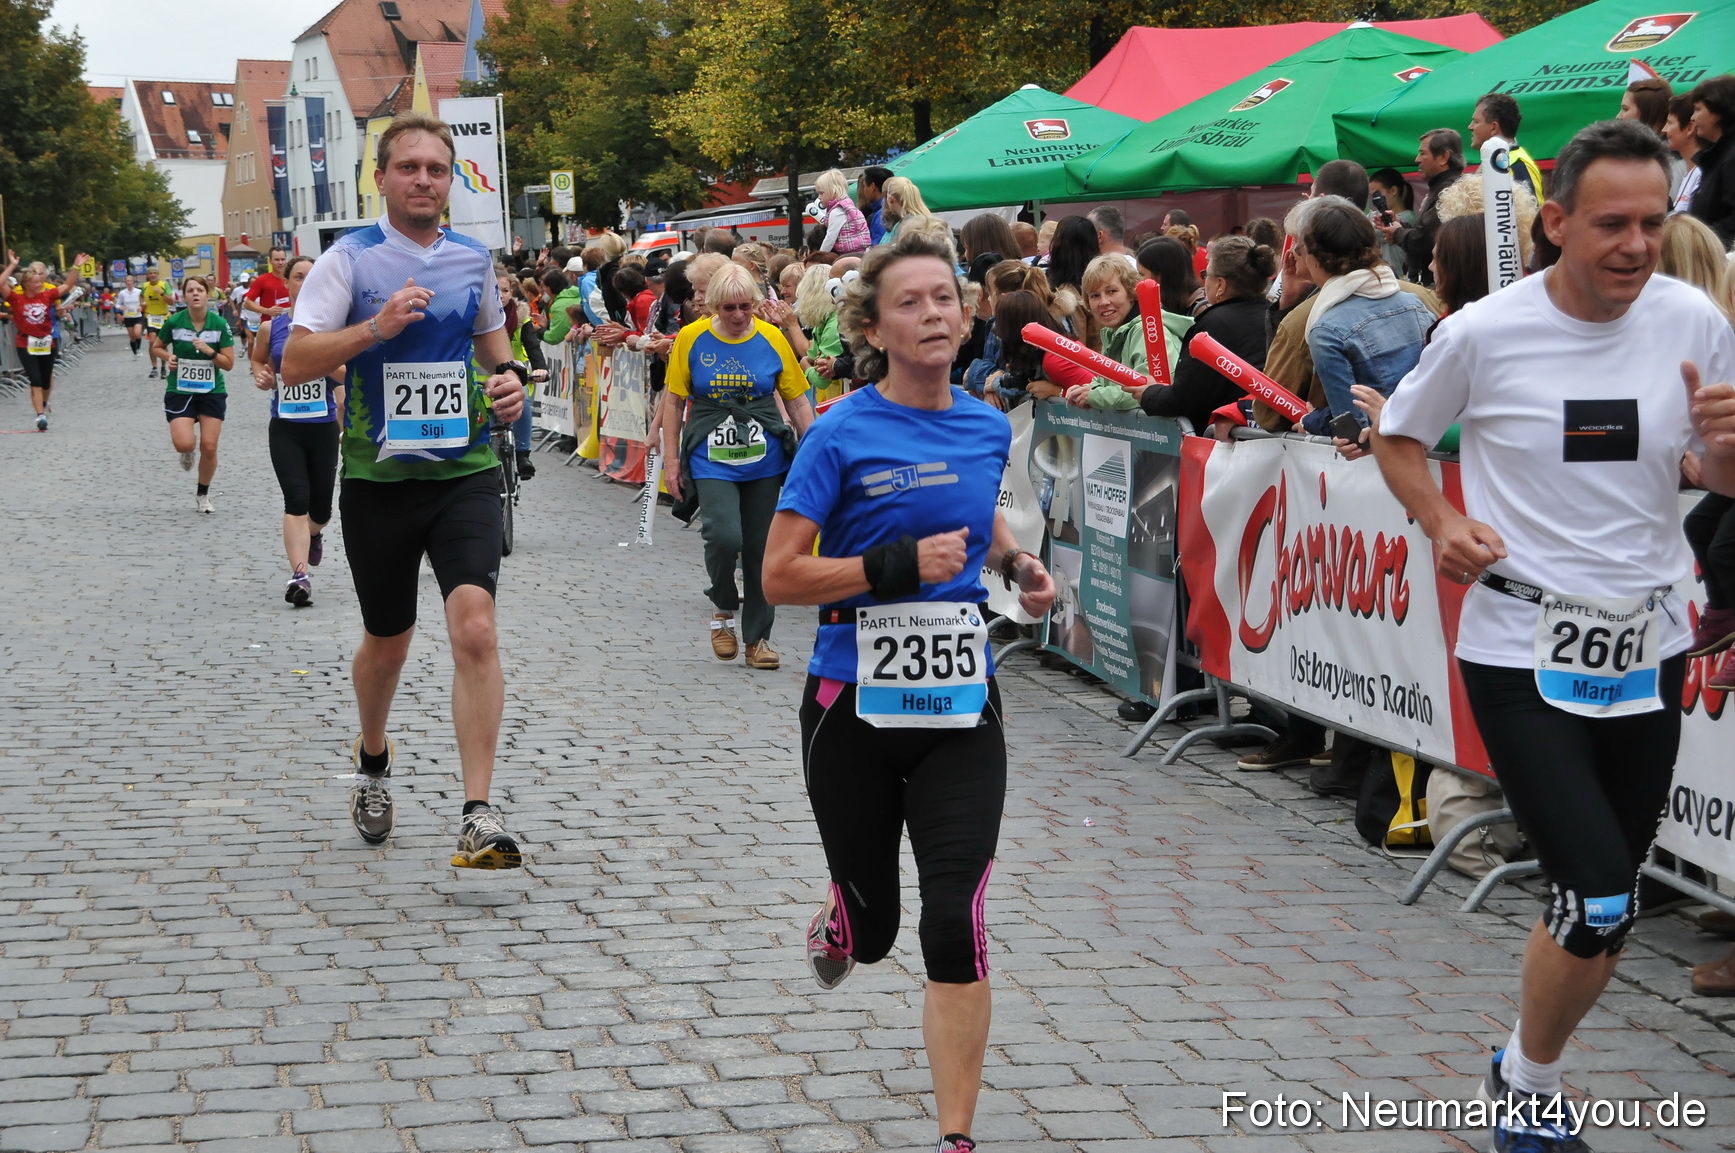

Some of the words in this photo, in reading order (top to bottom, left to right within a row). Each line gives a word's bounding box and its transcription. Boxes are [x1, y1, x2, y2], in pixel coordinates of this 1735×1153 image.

[1183, 117, 1260, 135] Neumarkter
[1005, 143, 1100, 156] Neumarkte
[987, 152, 1080, 168] Lamms
[1495, 189, 1514, 288] bmw-laufs
[84, 263, 92, 273] D
[1088, 352, 1114, 369] BKK
[1154, 353, 1162, 377] BKK
[181, 366, 212, 381] 2690
[386, 371, 417, 380] PARTL
[419, 371, 456, 380] Neumarkt
[1113, 363, 1141, 380] Audi
[283, 384, 321, 401] 2093
[1248, 377, 1273, 399] BKK
[395, 383, 462, 416] 2125
[1272, 396, 1301, 417] Audi
[294, 405, 311, 413] Jutta
[421, 423, 444, 439] Sigi
[714, 425, 760, 446] 502
[728, 450, 748, 458] Irene
[1103, 487, 1127, 504] HOFFER
[1504, 580, 1542, 598] SAUCONY
[1552, 600, 1593, 617] ARTL
[860, 617, 906, 631] PARTL
[909, 615, 967, 628] Neumarkt
[1550, 620, 1649, 672] 2661
[872, 633, 977, 681] 2355
[1290, 645, 1376, 708] Ostbayerns
[1380, 673, 1433, 727] Radio
[901, 693, 953, 714] Helga
